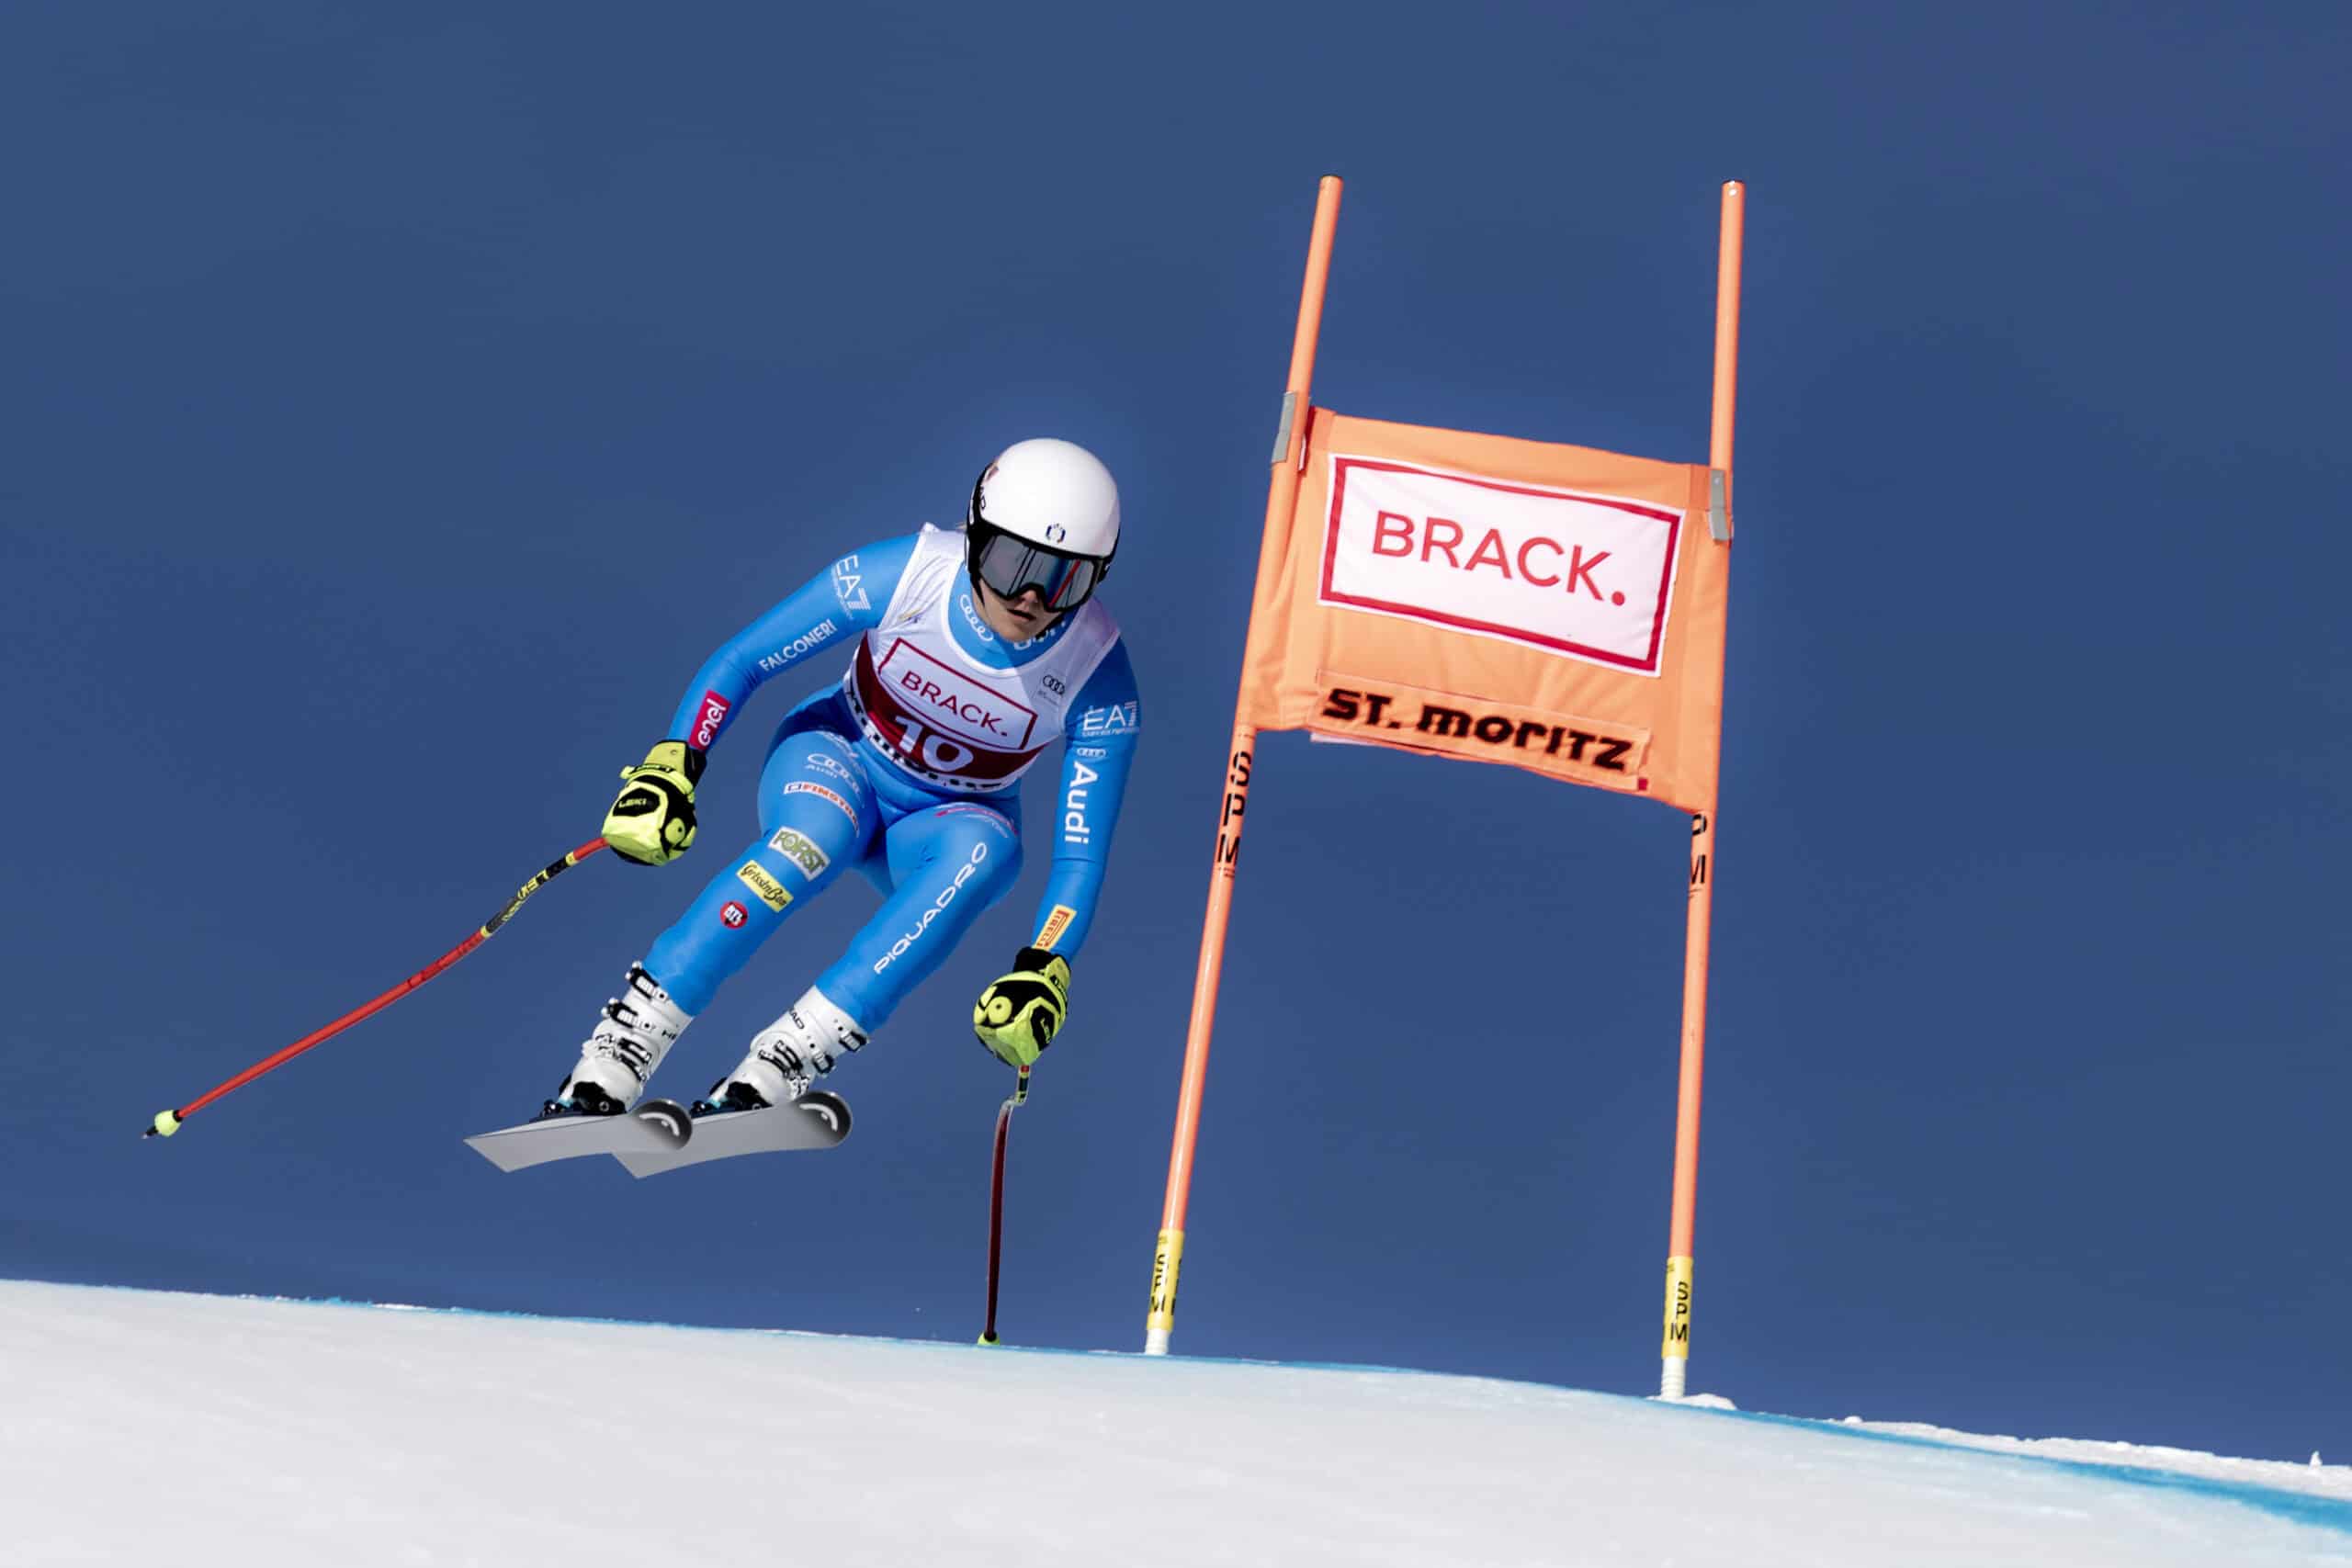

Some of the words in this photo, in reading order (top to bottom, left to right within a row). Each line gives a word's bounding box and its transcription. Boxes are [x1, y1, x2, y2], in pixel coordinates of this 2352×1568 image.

[836, 555, 872, 610] EA7
[1373, 510, 1625, 606] BRACK.
[758, 618, 838, 671] FALCONERI
[697, 697, 728, 747] enel
[900, 671, 1008, 737] BRACK.
[1082, 701, 1137, 731] EA7
[1321, 687, 1402, 730] ST.
[894, 716, 975, 773] 10
[1064, 760, 1100, 845] Audi
[772, 830, 827, 874] FORST
[873, 841, 988, 975] PIQUADRO
